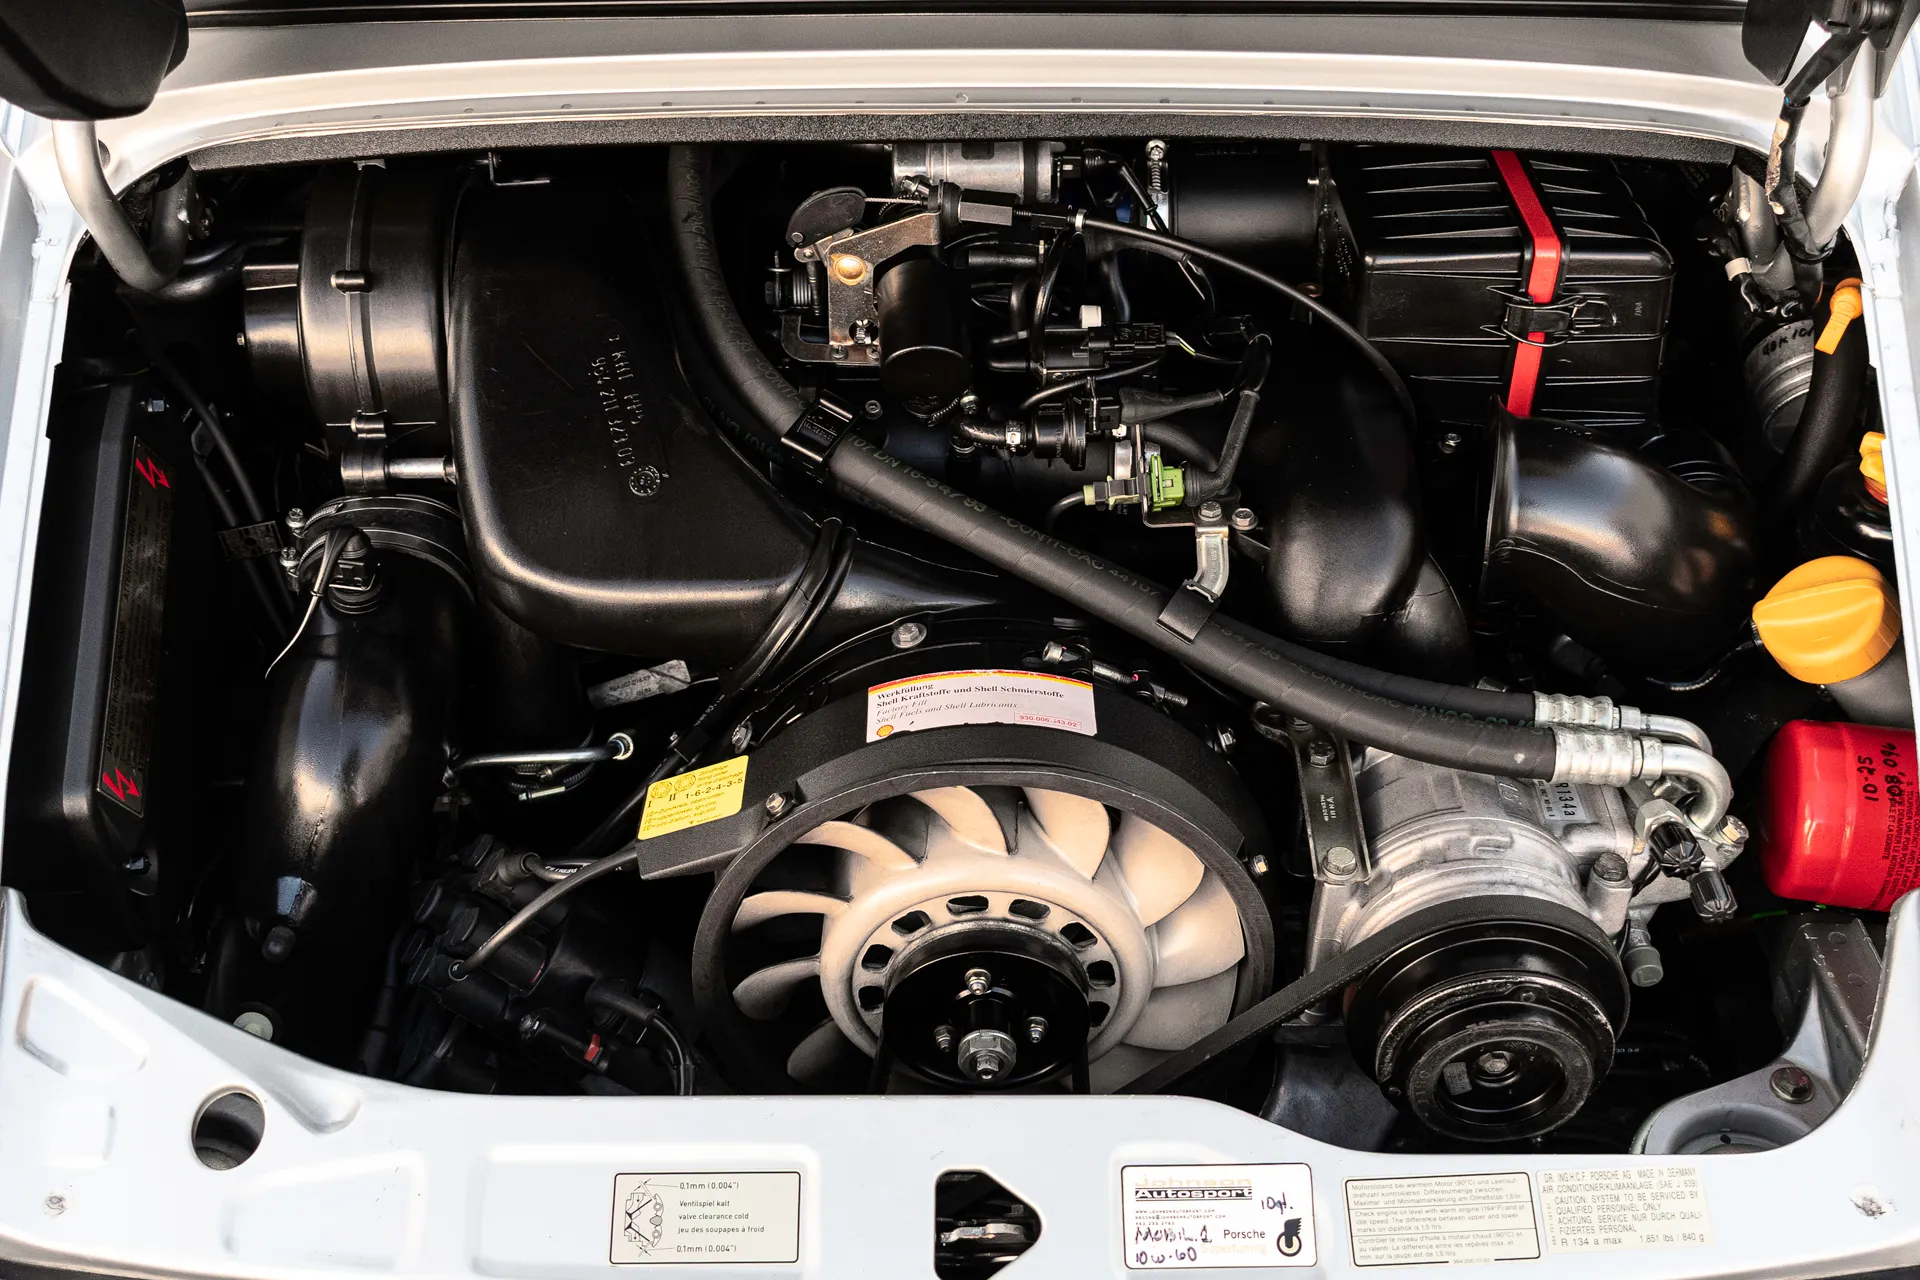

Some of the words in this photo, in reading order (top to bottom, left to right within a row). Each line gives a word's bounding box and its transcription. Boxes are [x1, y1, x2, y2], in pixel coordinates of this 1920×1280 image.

[876, 683, 934, 700] Werkfüllung
[876, 696, 898, 708] Shell
[901, 687, 952, 702] Kraftstoffe
[974, 684, 998, 692] Shell
[1000, 686, 1064, 698] Schmierstoffe
[876, 703, 909, 717] Factory
[876, 714, 897, 725] Shell
[899, 709, 922, 720] Fuels
[924, 705, 942, 713] and
[945, 701, 967, 710] Shell
[969, 700, 1018, 709] Lubricants
[107, 705, 117, 754] ACHTUNG
[685, 777, 743, 799] 1-6-2-4-3-5
[1555, 782, 1577, 816] R134a
[1589, 1170, 1619, 1180] PORSCHE
[1621, 1169, 1631, 1179] AG
[1636, 1168, 1654, 1178] MADE
[1656, 1168, 1664, 1178] IN
[1666, 1167, 1696, 1177] GERMANY
[1134, 1176, 1252, 1186] Johnson
[1541, 1184, 1553, 1193] AIR
[1656, 1179, 1672, 1189] (SAE
[1135, 1188, 1252, 1198] Autosport
[1473, 1185, 1504, 1193] zwischen
[1590, 1193, 1620, 1203] SYSTEM
[1623, 1192, 1634, 1202] TO
[1636, 1192, 1646, 1201] BE
[1650, 1190, 1686, 1200] SERVICED
[1688, 1190, 1699, 1199] BY
[1555, 1204, 1593, 1214] QUALIFIED
[1596, 1202, 1639, 1213] PERSONNEL
[1641, 1201, 1662, 1211] ONLY
[1404, 1215, 1436, 1223] difference
[1597, 1213, 1628, 1223] SERVICE
[1630, 1212, 1647, 1222] NUR
[1650, 1211, 1676, 1221] DURCH
[677, 1226, 688, 1234] jeu
[1223, 1228, 1265, 1238] Porsche
[1558, 1225, 1595, 1235] FIZIERTES
[1598, 1223, 1636, 1233] PERSONAL
[1560, 1237, 1568, 1246] R
[1571, 1236, 1589, 1246] 134
[1592, 1236, 1599, 1245] a
[1602, 1235, 1622, 1244] max
[1639, 1233, 1659, 1243] 1.851
[1662, 1233, 1674, 1242] lbs
[1681, 1232, 1696, 1241] 840
